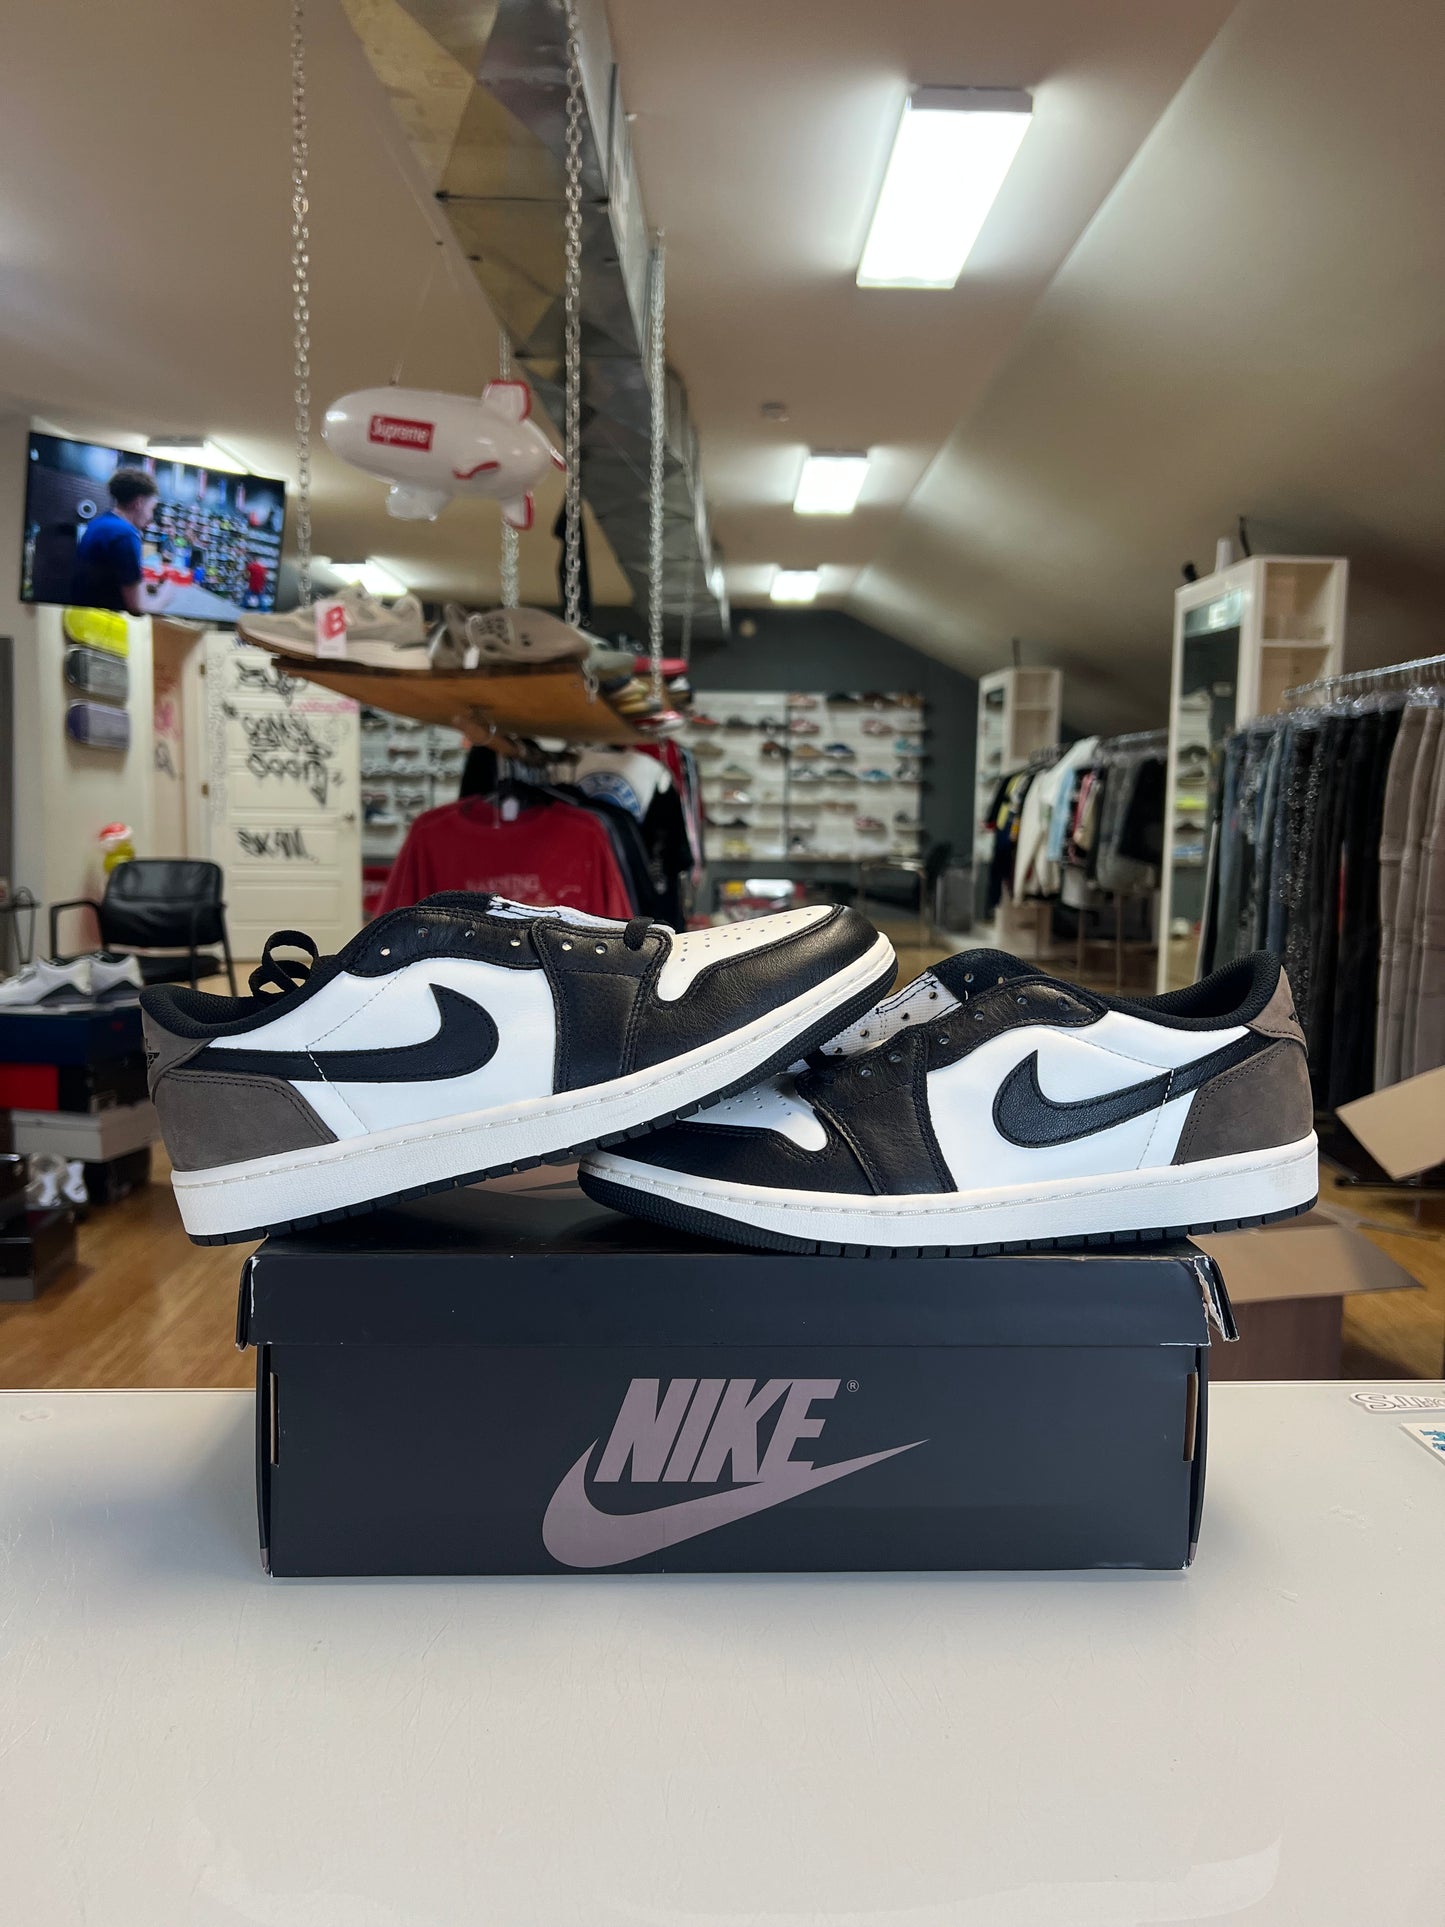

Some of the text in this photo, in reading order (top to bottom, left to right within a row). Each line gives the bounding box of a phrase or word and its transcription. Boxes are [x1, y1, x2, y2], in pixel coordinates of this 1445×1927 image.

[372, 417, 430, 444] Supreme
[323, 605, 347, 640] B
[592, 1378, 842, 1483] NIKE
